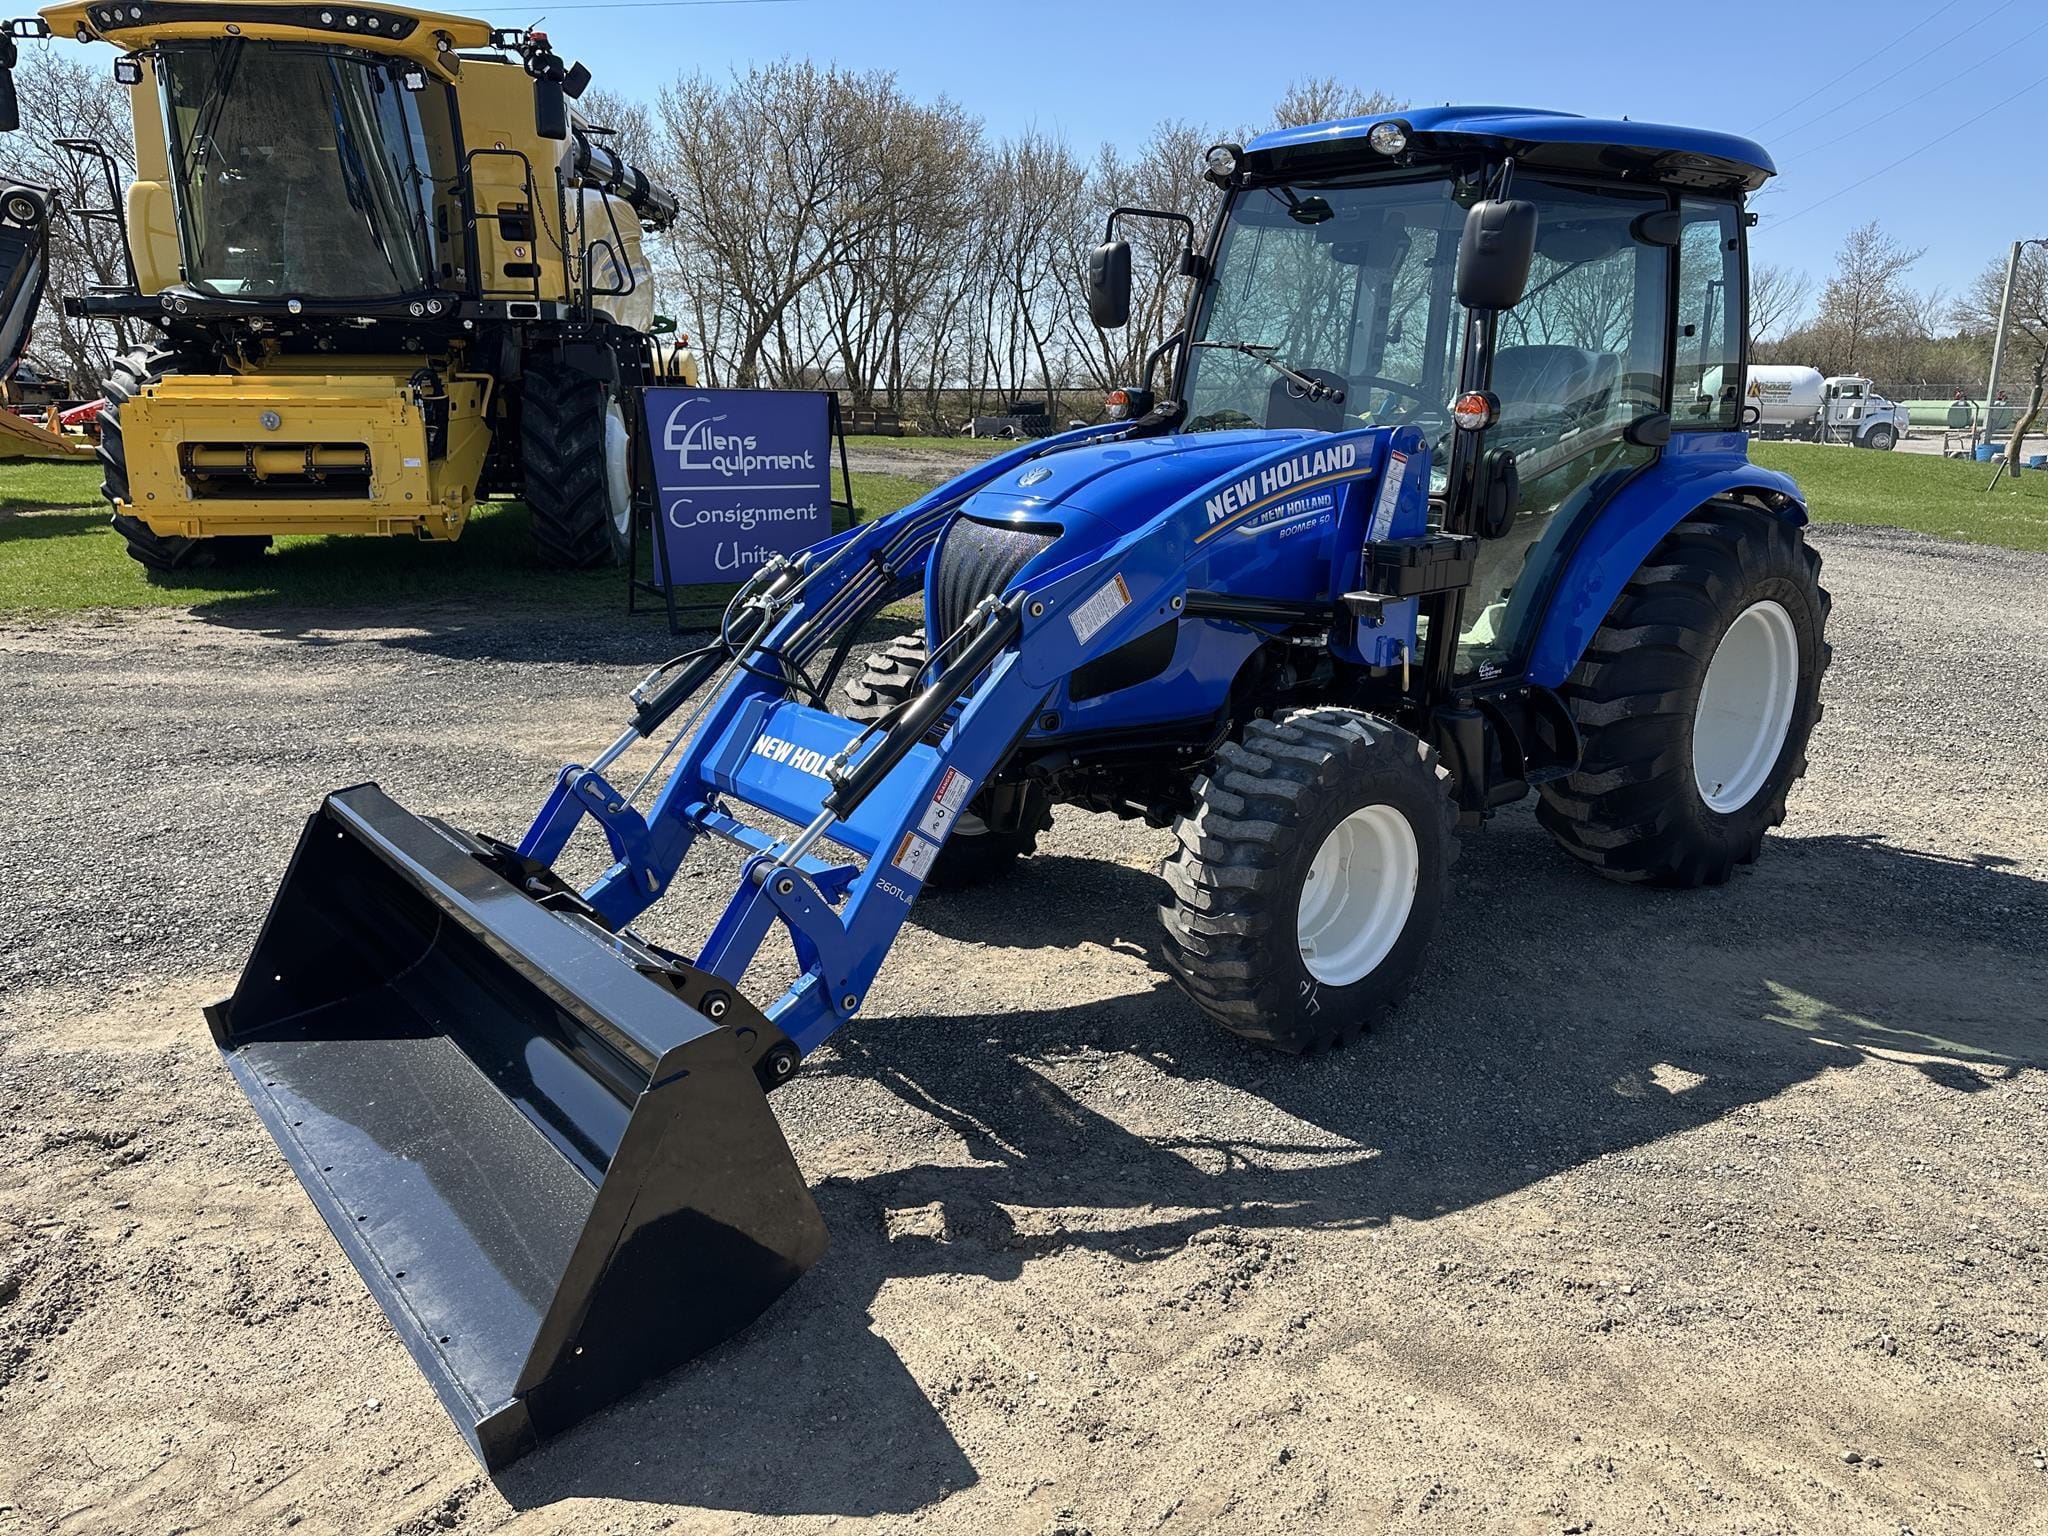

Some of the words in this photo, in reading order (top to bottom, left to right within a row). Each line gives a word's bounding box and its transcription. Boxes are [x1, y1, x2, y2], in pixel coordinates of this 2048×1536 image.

[664, 397, 757, 451] Ellens
[680, 414, 816, 477] Equipment
[1205, 475, 1256, 525] NEW
[1261, 443, 1356, 496] HOLLAND
[669, 499, 818, 531] Consignment
[1260, 505, 1284, 522] NEW
[1286, 494, 1332, 516] HOLLAND
[1279, 518, 1317, 539] BOOMER
[1319, 514, 1331, 525] 50
[714, 541, 778, 570] Units
[751, 734, 795, 763] NEW
[875, 877, 914, 906] 260TLA
